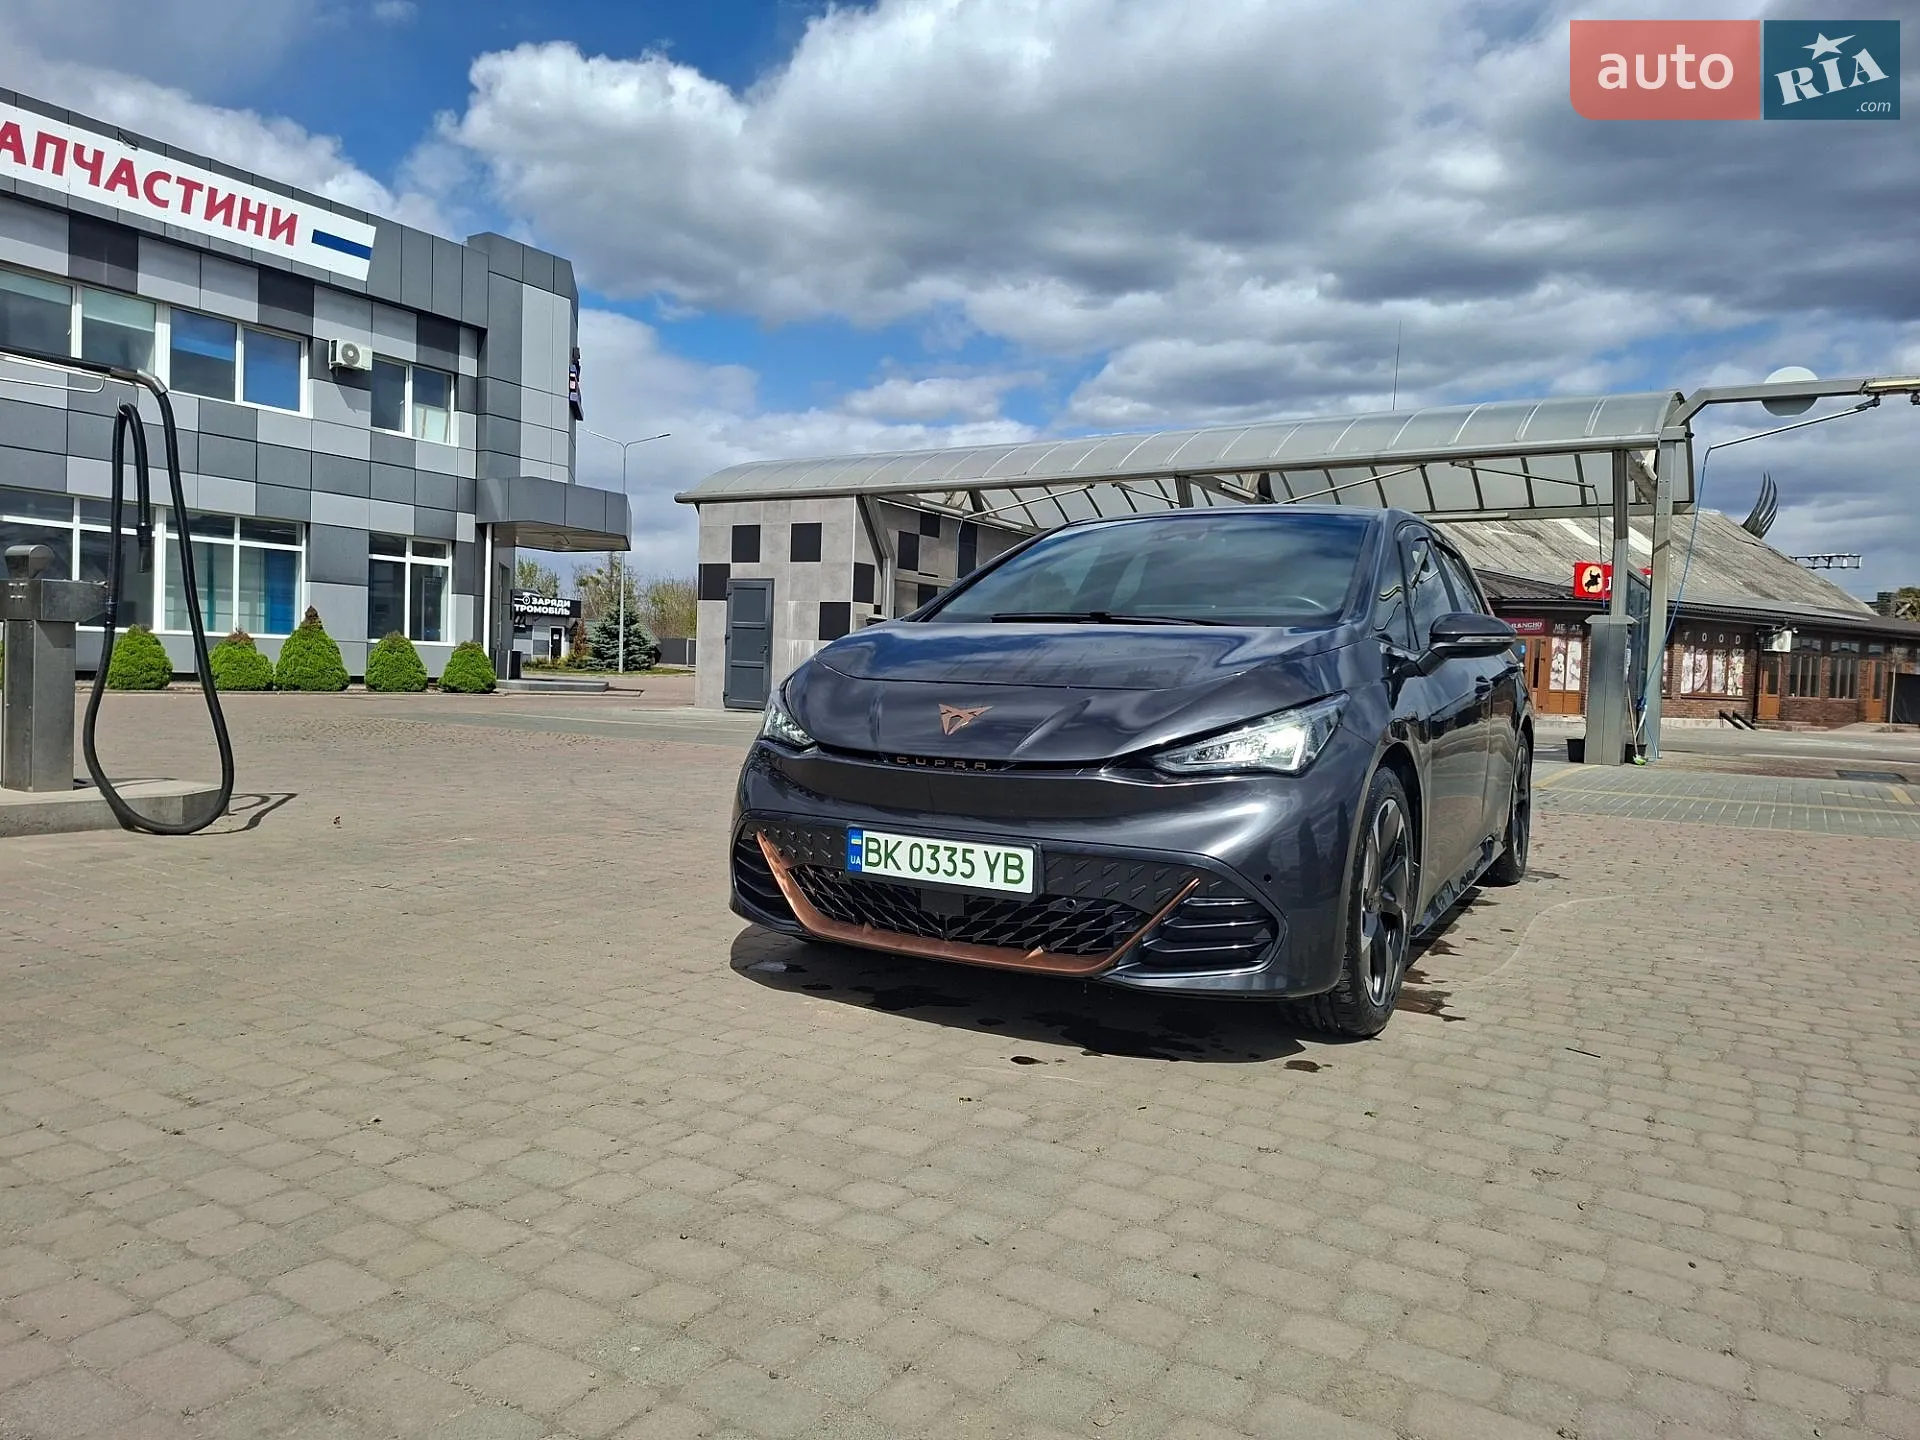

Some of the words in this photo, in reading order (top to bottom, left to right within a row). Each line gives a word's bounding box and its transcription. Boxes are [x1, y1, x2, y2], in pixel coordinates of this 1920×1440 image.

[0, 120, 299, 247] АПЧАСТИНИ
[531, 597, 571, 608] ЗАРЯДИ
[514, 603, 570, 616] ТРОМОБІЛЬ
[896, 756, 987, 770] CUPRA
[850, 856, 861, 866] UA
[864, 836, 903, 871] BK
[908, 842, 976, 879] 0335
[983, 850, 1025, 885] YB
